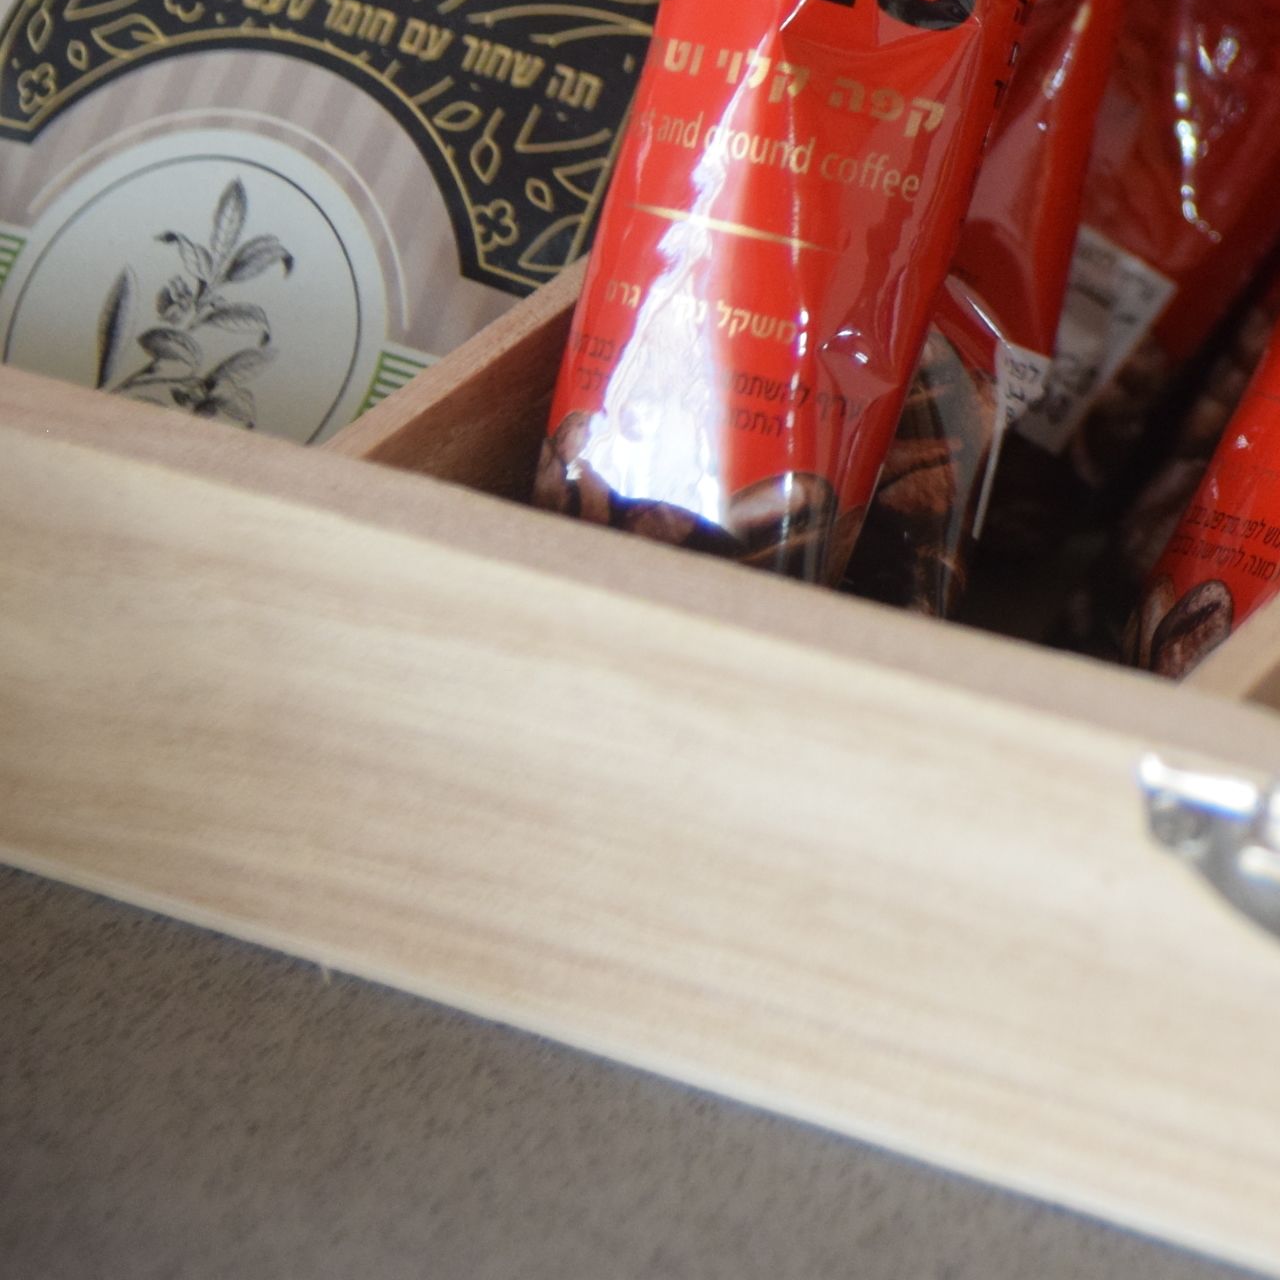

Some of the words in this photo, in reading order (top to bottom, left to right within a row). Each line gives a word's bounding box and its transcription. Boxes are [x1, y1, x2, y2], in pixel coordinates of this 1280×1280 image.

[398, 17, 453, 62] עם
[461, 33, 545, 89] שחור
[546, 60, 604, 111] תה
[828, 76, 945, 138] קפה
[656, 111, 705, 149] and
[820, 151, 920, 202] coffee
